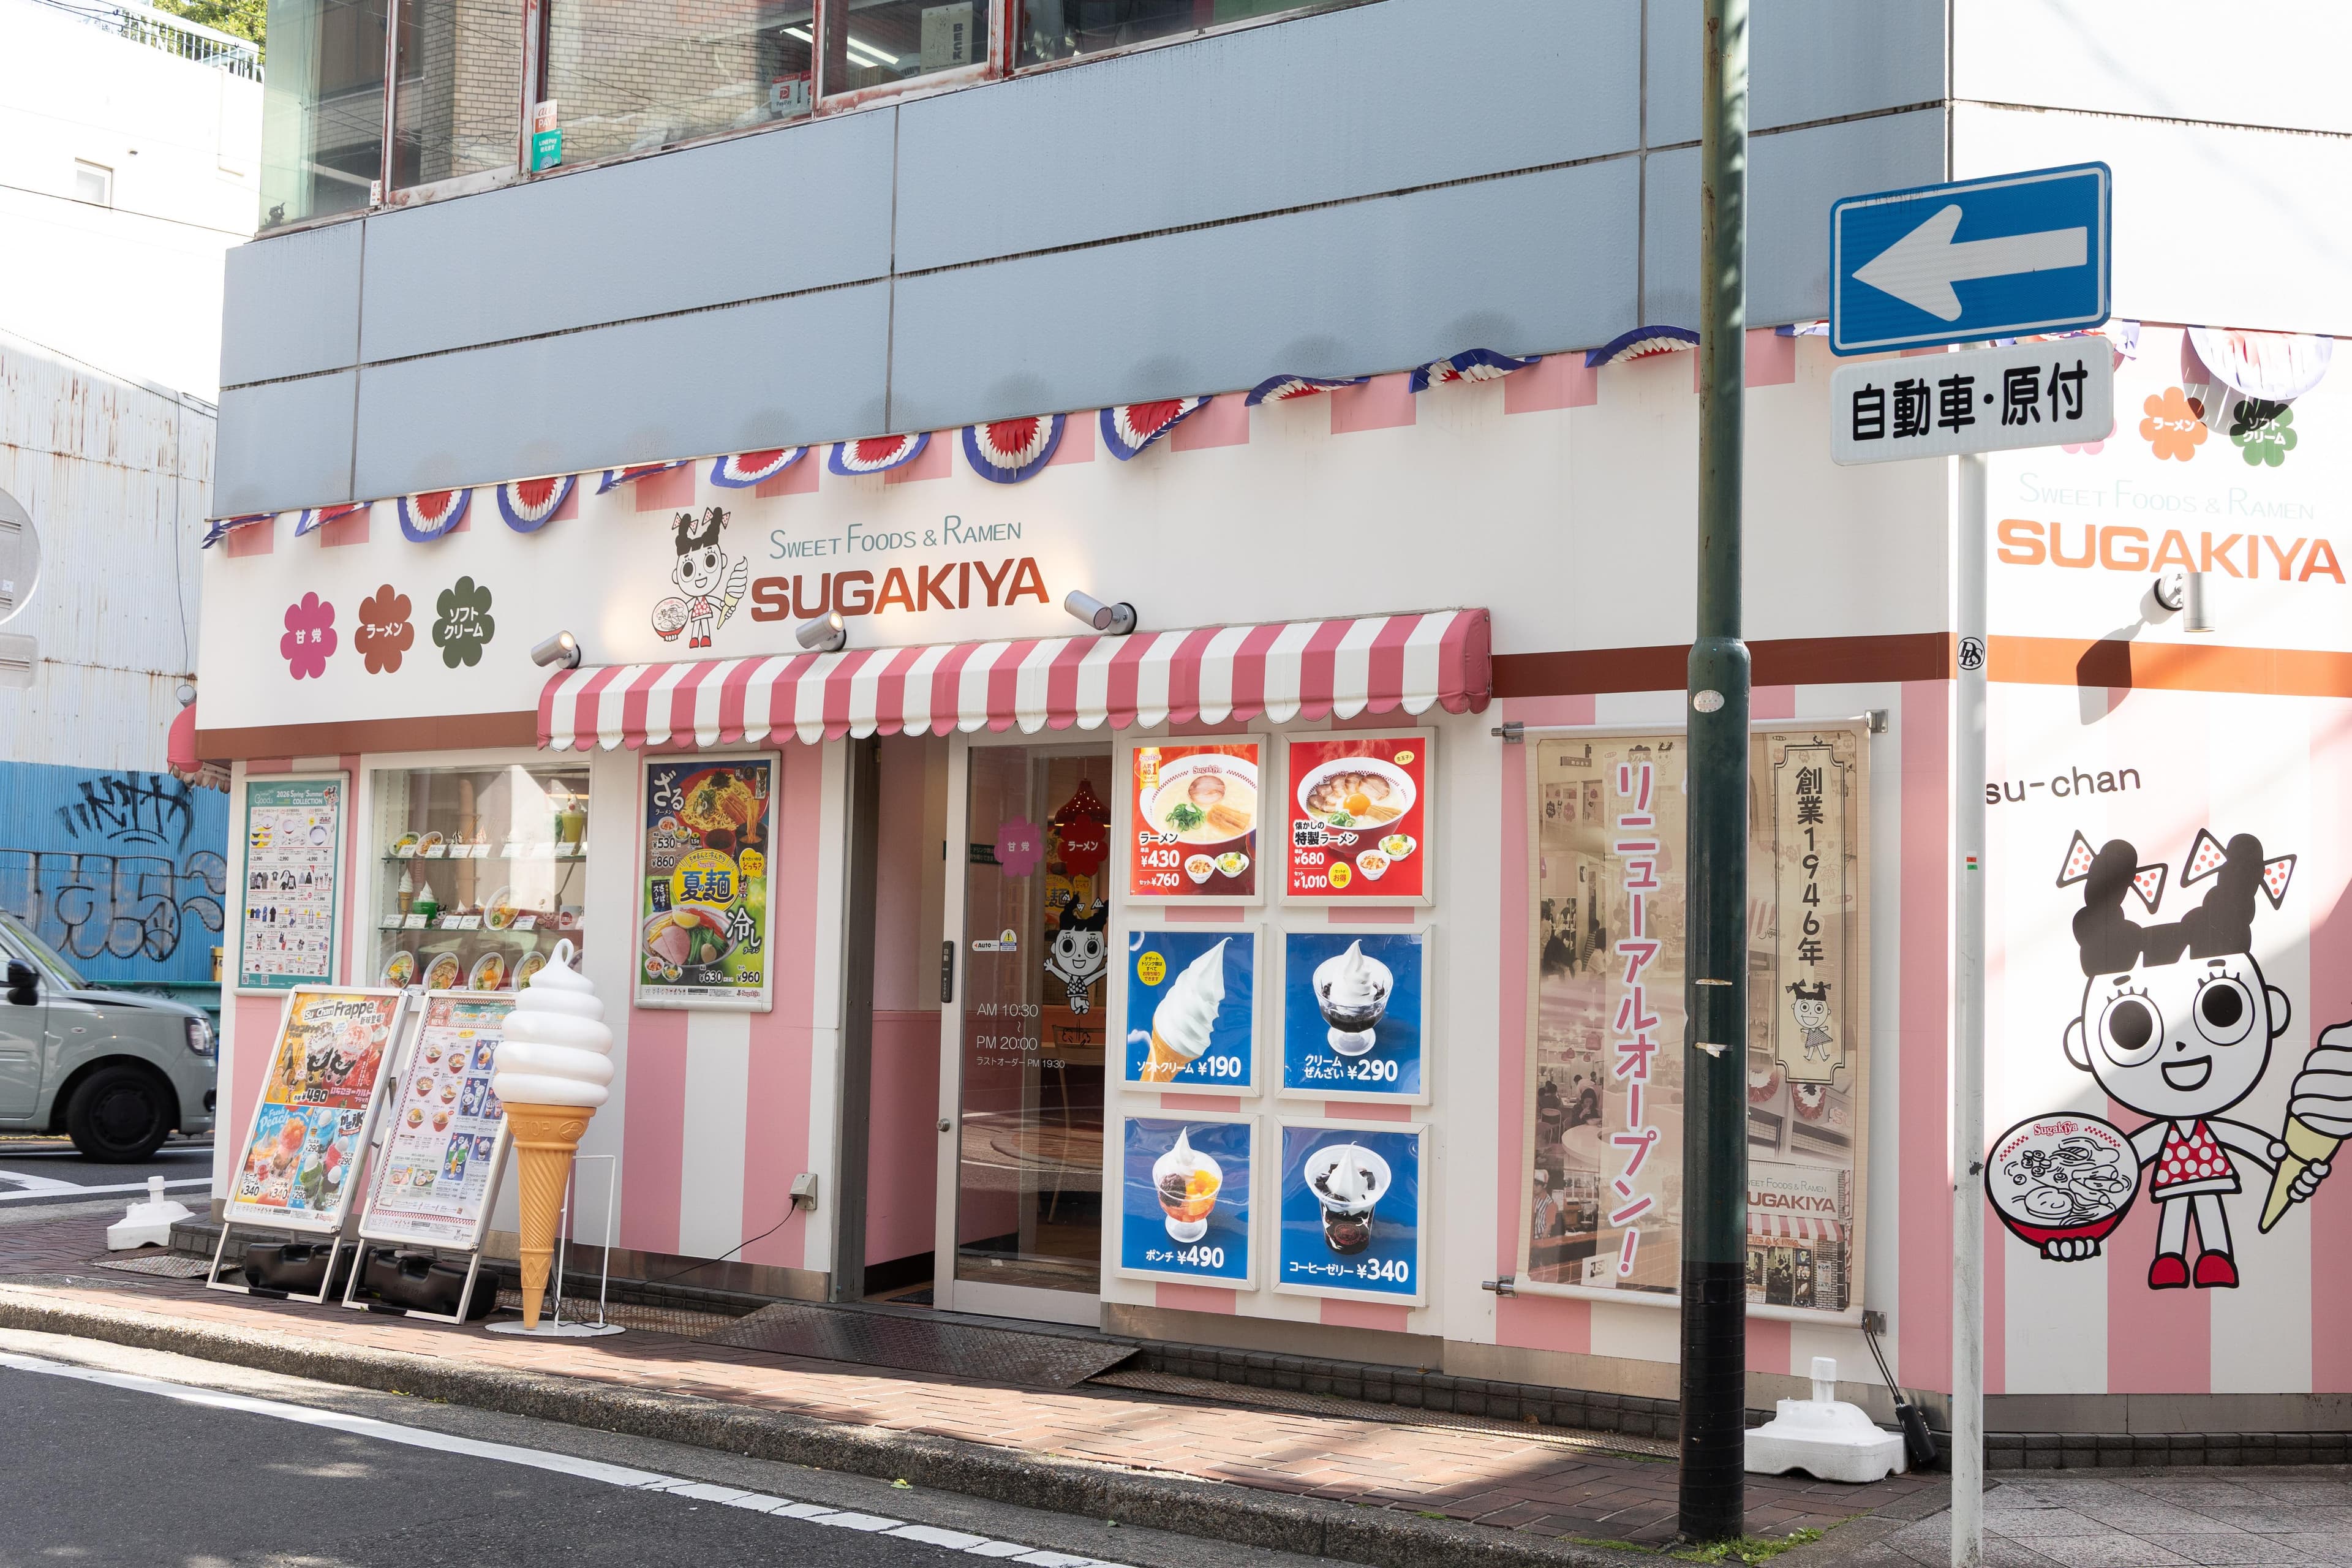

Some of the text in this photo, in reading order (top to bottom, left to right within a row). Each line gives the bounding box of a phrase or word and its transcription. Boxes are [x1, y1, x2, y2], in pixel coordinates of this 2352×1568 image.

[952, 23, 963, 61] BECK
[538, 118, 552, 128] PAY
[1852, 359, 2088, 442] 自動車・原付
[2152, 417, 2197, 432] ラーメン
[2248, 417, 2280, 432] ソフト
[2242, 430, 2286, 446] クリーム
[2205, 498, 2221, 514] &
[922, 529, 938, 547] &
[1997, 519, 2346, 584] SUGAKIYA
[751, 557, 1050, 623] SUGAKIYA
[450, 606, 479, 623] ソフト
[366, 622, 403, 639] ラーメン
[444, 623, 484, 640] クリーム
[1193, 764, 1222, 774] Sugakiya
[653, 770, 684, 811] ざる
[1295, 821, 1325, 830] 懐かしの
[652, 837, 676, 848] ¥530
[1068, 840, 1098, 851] ラーメン
[1140, 833, 1178, 844] ラーメン
[1295, 831, 1357, 846] 特製ラーメン
[652, 856, 674, 867] ¥860
[1141, 850, 1180, 868] ¥430
[1294, 852, 1325, 865] ¥680
[1795, 766, 1825, 967] 創業1946年
[1151, 873, 1180, 887] ¥760
[1294, 875, 1327, 889] ¥1,010
[1333, 873, 1346, 882] お得
[680, 869, 734, 903] 夏の麺
[726, 907, 761, 947] 冷し
[699, 971, 723, 982] ¥630
[737, 971, 760, 983] ¥960
[334, 1001, 375, 1019] Frappe
[976, 1003, 1038, 1017] AM 10:30
[1613, 766, 1658, 1273] リニューアルオープン!
[976, 1036, 1038, 1050] PM 20:00
[976, 1057, 1025, 1067] ラストオーダー
[1042, 1060, 1065, 1069] 19:30
[1137, 1055, 1242, 1078] ソフトクリーム ¥190
[1305, 1055, 1342, 1067] クリーム
[1303, 1067, 1344, 1079] ぜんざい
[1348, 1059, 1398, 1082] ¥290
[301, 1089, 328, 1102] ¥490
[259, 1111, 290, 1133] Peach
[2034, 1121, 2079, 1136] Sugakiya
[241, 1185, 260, 1196] ¥340
[1747, 1191, 1836, 1213] UGAKIYA
[1145, 1245, 1224, 1268] ポンチ ¥490
[1289, 1258, 1408, 1283] コーヒーゼリー ¥340
